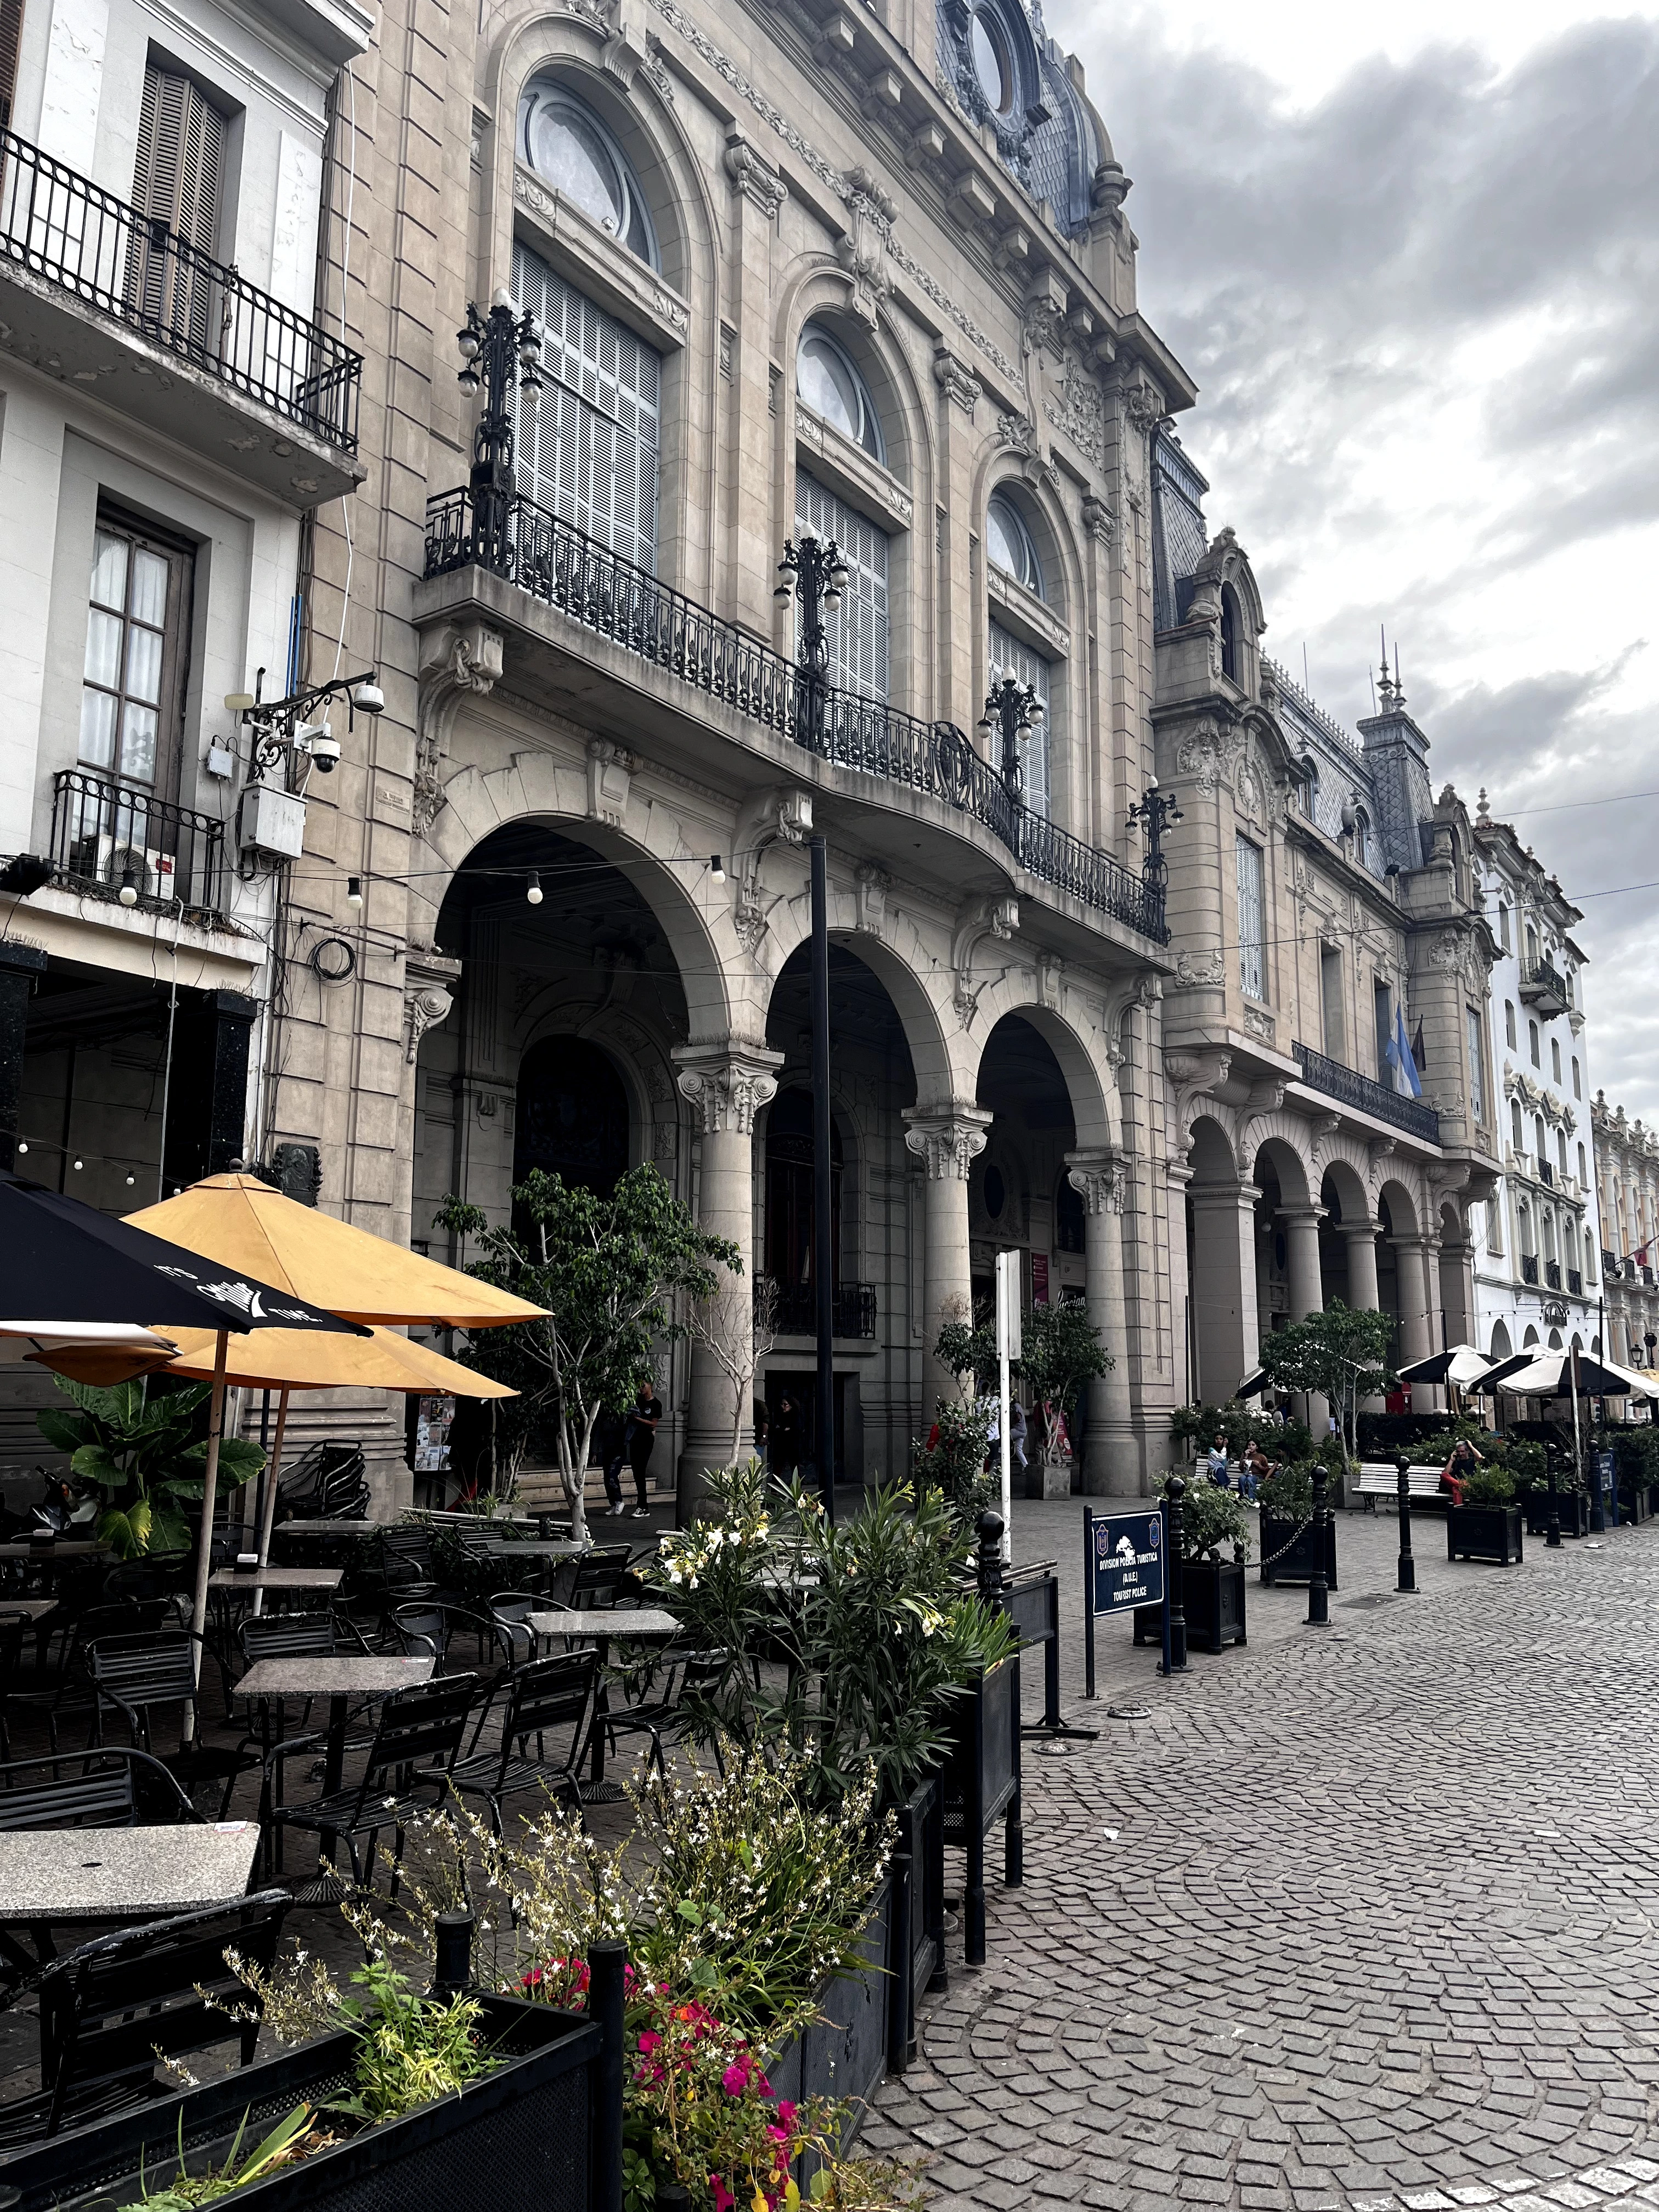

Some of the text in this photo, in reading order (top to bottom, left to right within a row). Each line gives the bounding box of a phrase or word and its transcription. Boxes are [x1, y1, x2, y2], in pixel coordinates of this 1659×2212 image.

[196, 1281, 255, 1313] Miller
[1099, 1552, 1158, 1571] DIVISION POLICIA TURISTICA
[1113, 1585, 1147, 1602] TOURIST POLICE
